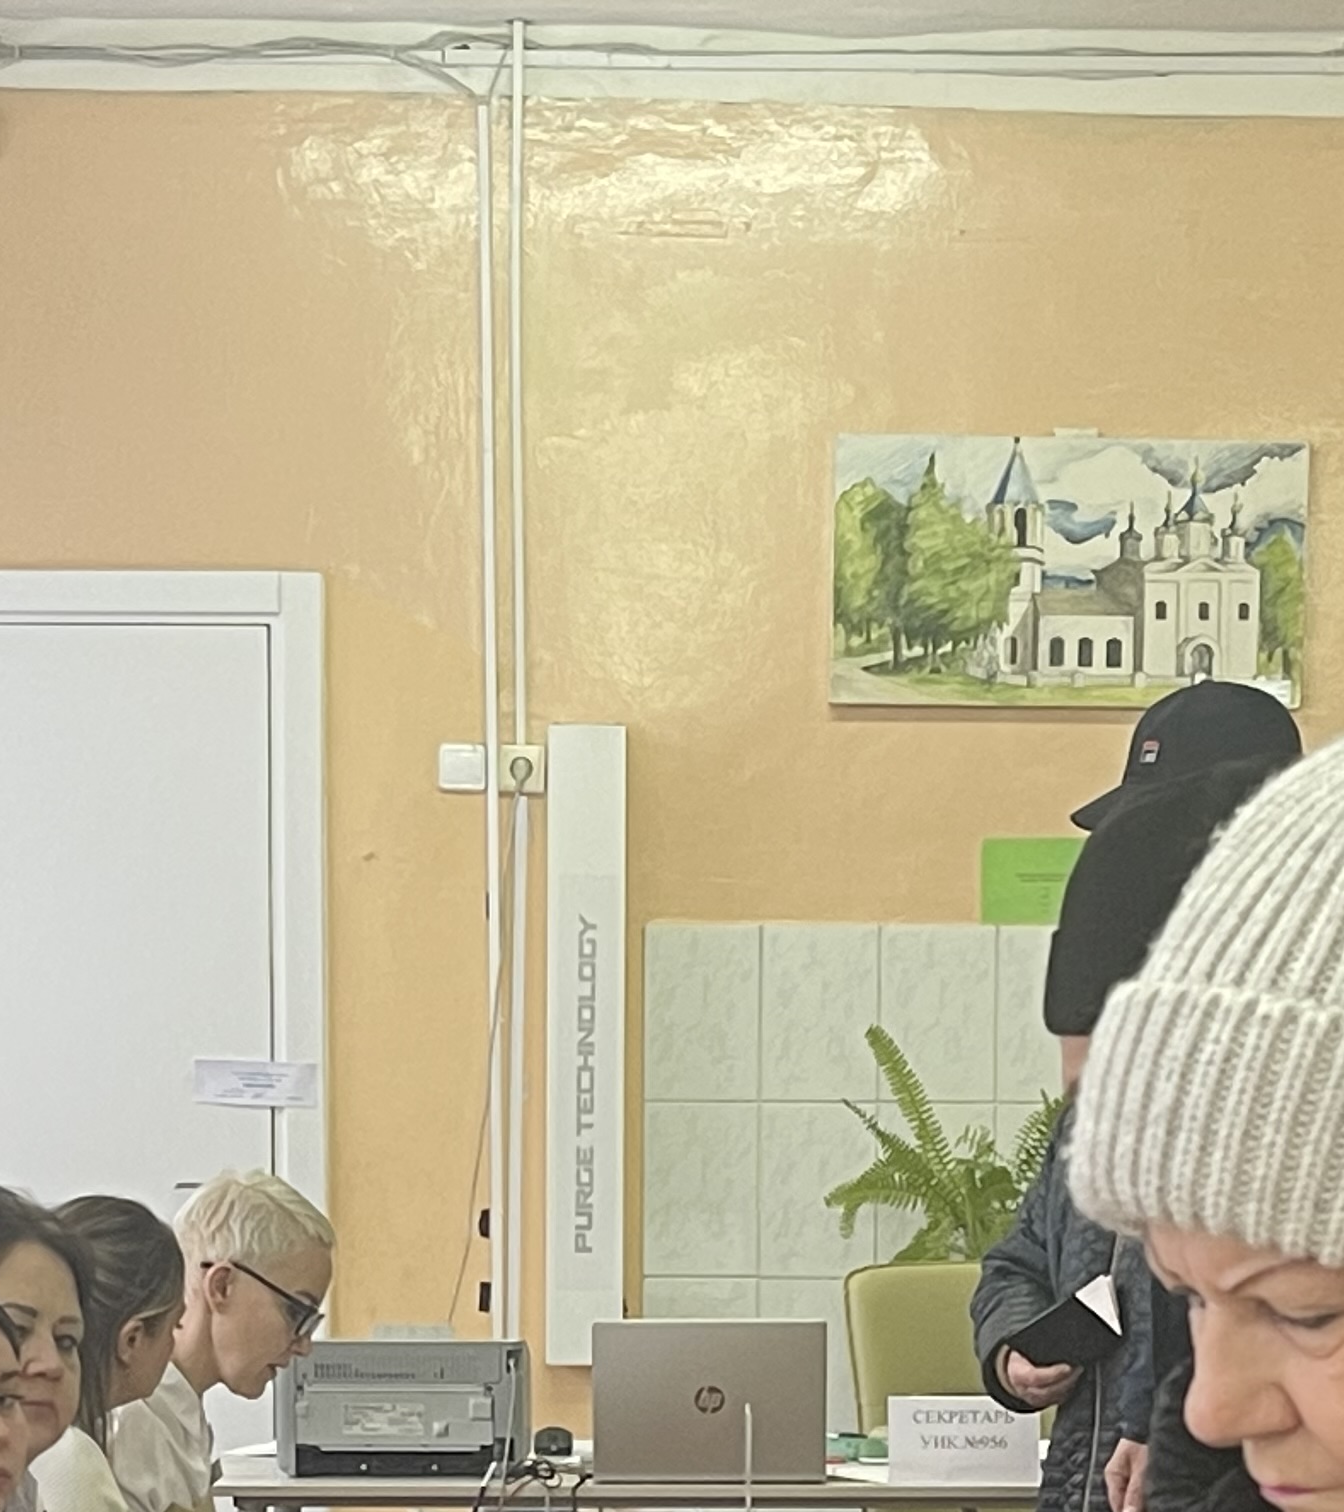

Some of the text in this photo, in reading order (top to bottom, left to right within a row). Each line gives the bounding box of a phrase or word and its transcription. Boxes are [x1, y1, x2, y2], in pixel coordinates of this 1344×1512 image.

[574, 913, 598, 1254] PURGE TECHNOLOGY
[912, 1409, 1016, 1425] СЕКРЕТАРЬ
[920, 1434, 960, 1449] УИК
